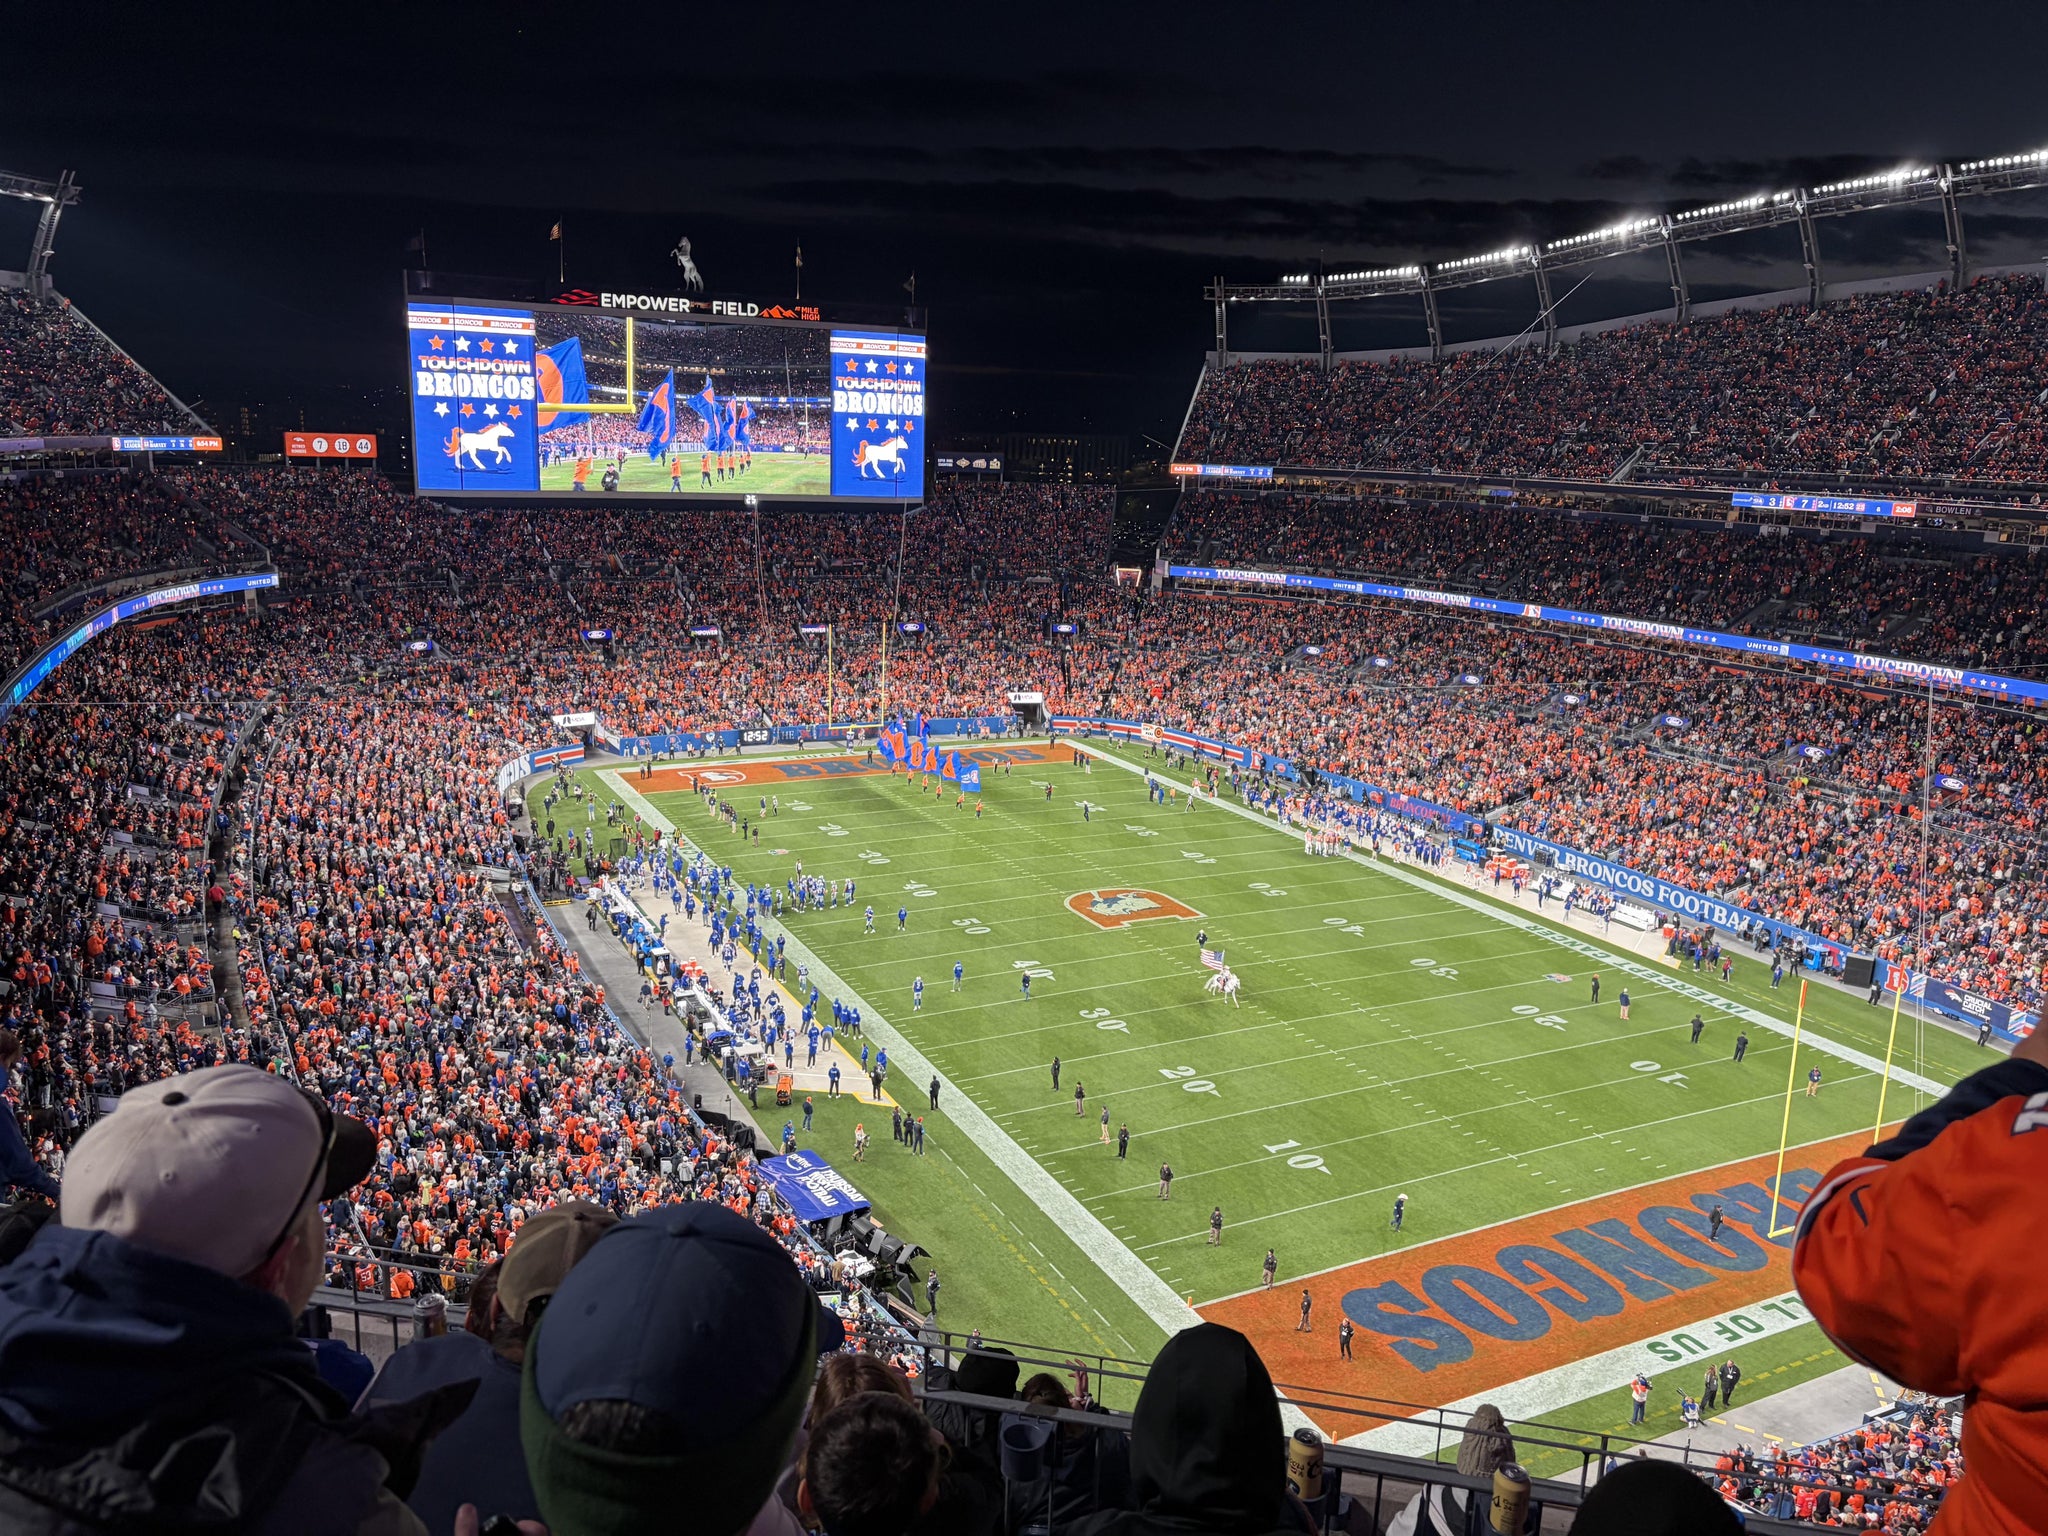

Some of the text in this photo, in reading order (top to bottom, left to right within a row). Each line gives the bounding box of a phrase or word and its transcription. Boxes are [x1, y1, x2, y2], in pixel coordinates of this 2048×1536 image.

[601, 293, 759, 317] EMPOWER FIELD
[802, 307, 819, 315] MILE
[801, 313, 820, 321] HIGH
[418, 356, 531, 375] TOUCHDOWN
[416, 371, 535, 400] BRONCOS
[836, 376, 921, 393] TOUCHDOWN
[833, 390, 923, 416] BRONCOS
[317, 440, 323, 450] 7
[337, 441, 348, 451] 18
[358, 441, 369, 451] 44
[1769, 497, 1776, 506] 3
[1801, 499, 1808, 508] 7
[1833, 501, 1855, 511] 12:52
[1935, 506, 1972, 516] BOWLEN
[247, 578, 271, 586] UNITED
[1333, 582, 1356, 590] UNITED
[1746, 642, 1779, 653] UNITED
[1852, 654, 1964, 685] TOUCHDOWN!
[743, 730, 768, 742] 12:52
[817, 822, 850, 837] 20
[858, 849, 891, 865] 30
[1493, 827, 1559, 870] DENVR
[1565, 853, 1655, 897] BRONCOS
[903, 879, 938, 898] 40
[1247, 882, 1288, 897] 50
[952, 917, 991, 935] 50
[1322, 917, 1366, 935] 40
[1011, 959, 1054, 978] 40
[1410, 958, 1460, 977] 30
[1525, 925, 1750, 1013] INTERCEPT CANCER
[1962, 1000, 1985, 1014] CATCH
[1963, 994, 1993, 1011] CRUCIAL
[1079, 1007, 1128, 1031] 30
[1511, 1005, 1568, 1028] 20
[1158, 1065, 1216, 1093] 20
[1629, 1060, 1690, 1085] 10
[788, 1153, 812, 1168] prime
[1263, 1139, 1324, 1169] 10
[809, 1171, 837, 1191] NIGHT
[821, 1169, 868, 1202] THURSDAY
[796, 1176, 840, 1207] FOOTBALL
[361, 1270, 371, 1282] 53
[1713, 1314, 1766, 1343] OF
[1646, 1333, 1710, 1362] US
